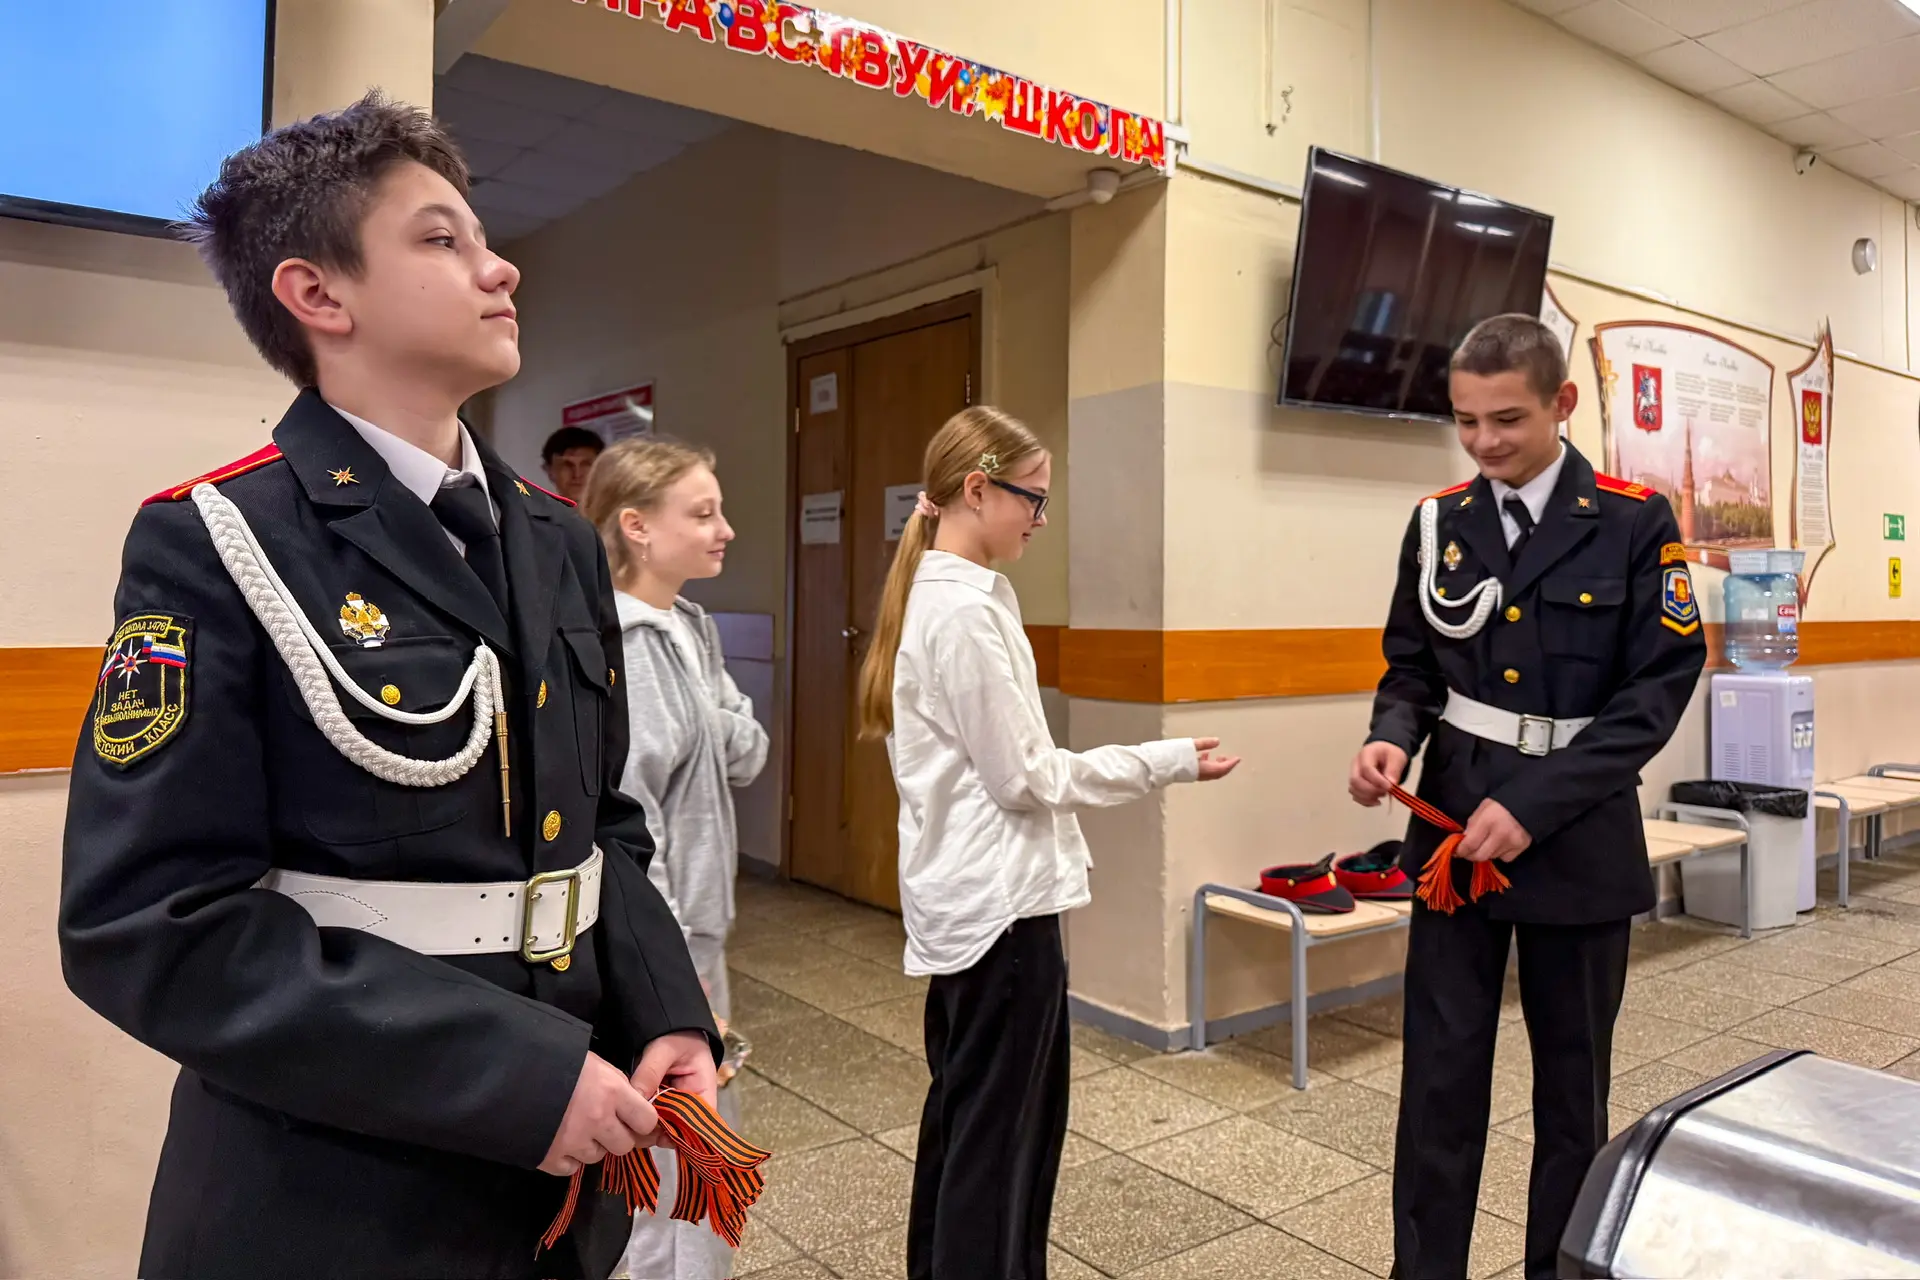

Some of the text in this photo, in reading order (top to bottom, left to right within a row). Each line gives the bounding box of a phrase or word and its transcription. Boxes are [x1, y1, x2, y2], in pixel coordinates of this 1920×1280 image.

[572, 0, 1167, 171] АВСТВУЙ, ШКОЛА!
[111, 699, 145, 712] ЗАДАЧ
[118, 689, 138, 700] НЕТ
[143, 703, 180, 744] КЛАСС
